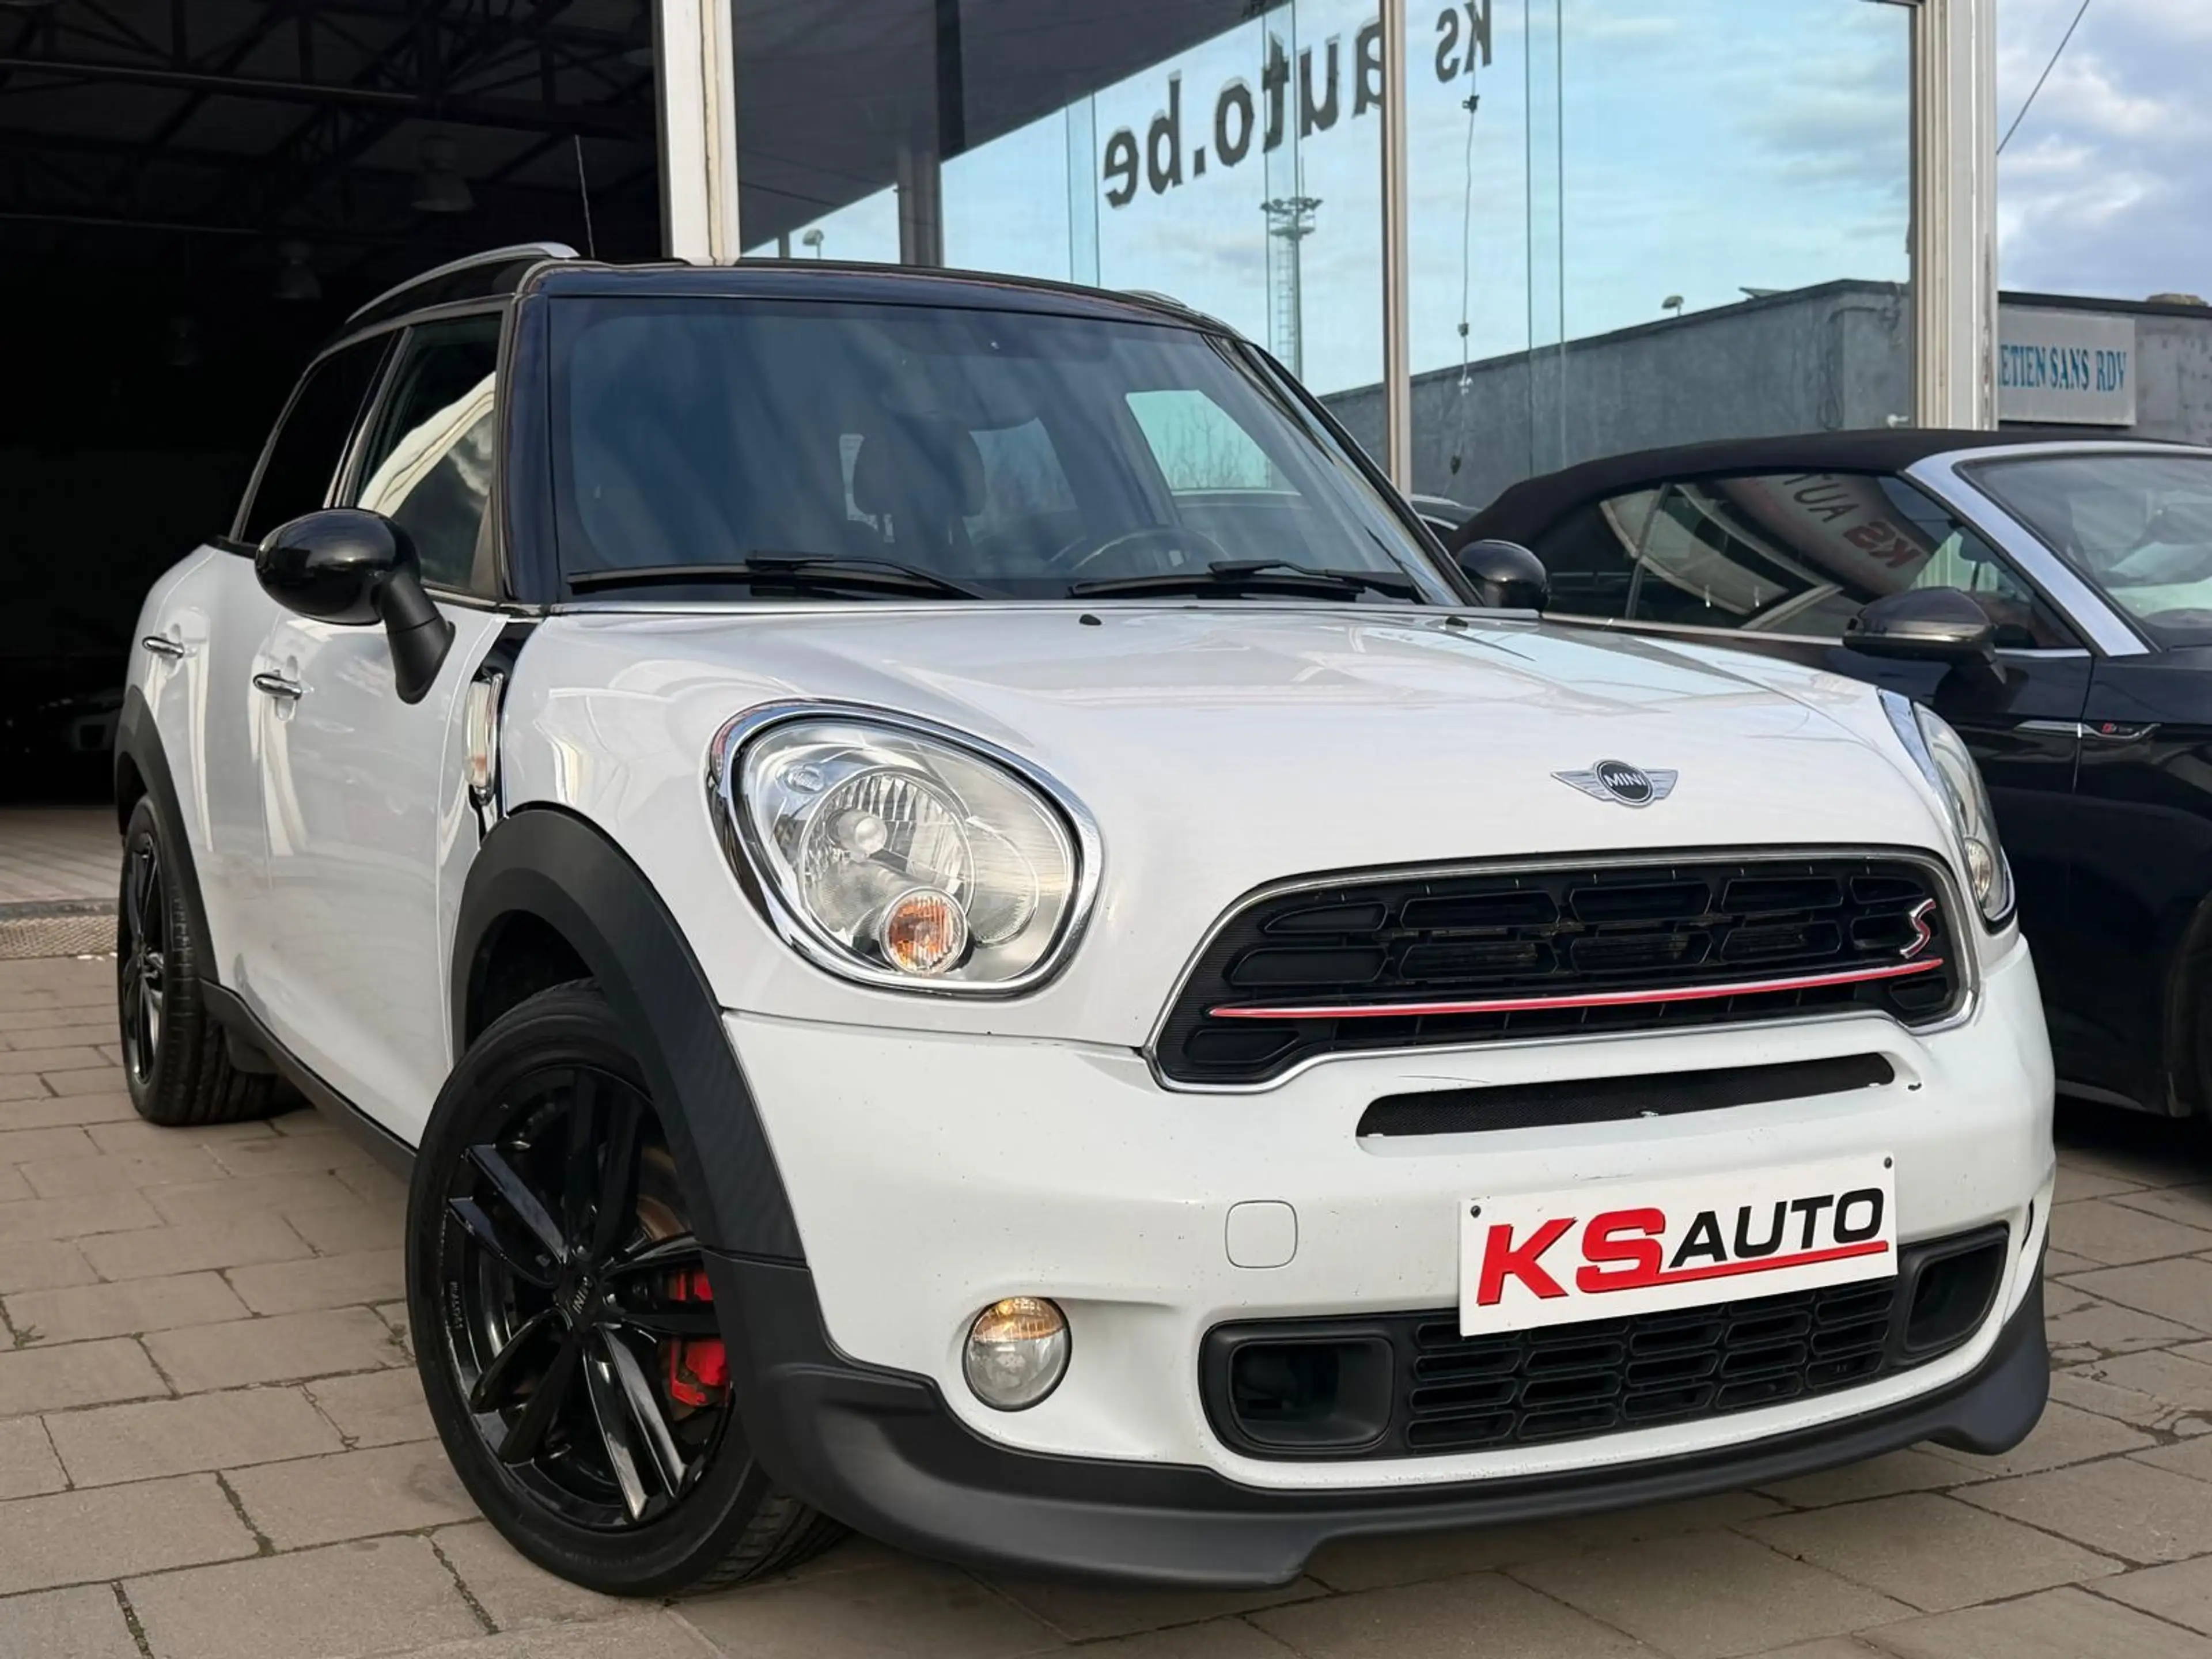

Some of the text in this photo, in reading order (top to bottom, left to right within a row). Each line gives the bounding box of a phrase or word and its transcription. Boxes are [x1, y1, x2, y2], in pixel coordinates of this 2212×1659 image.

[1999, 344, 2127, 392] ETIEN SANS RDV
[1603, 772, 1647, 787] MINI
[1899, 897, 1937, 959] S
[1475, 1187, 1885, 1306] KS AUTO
